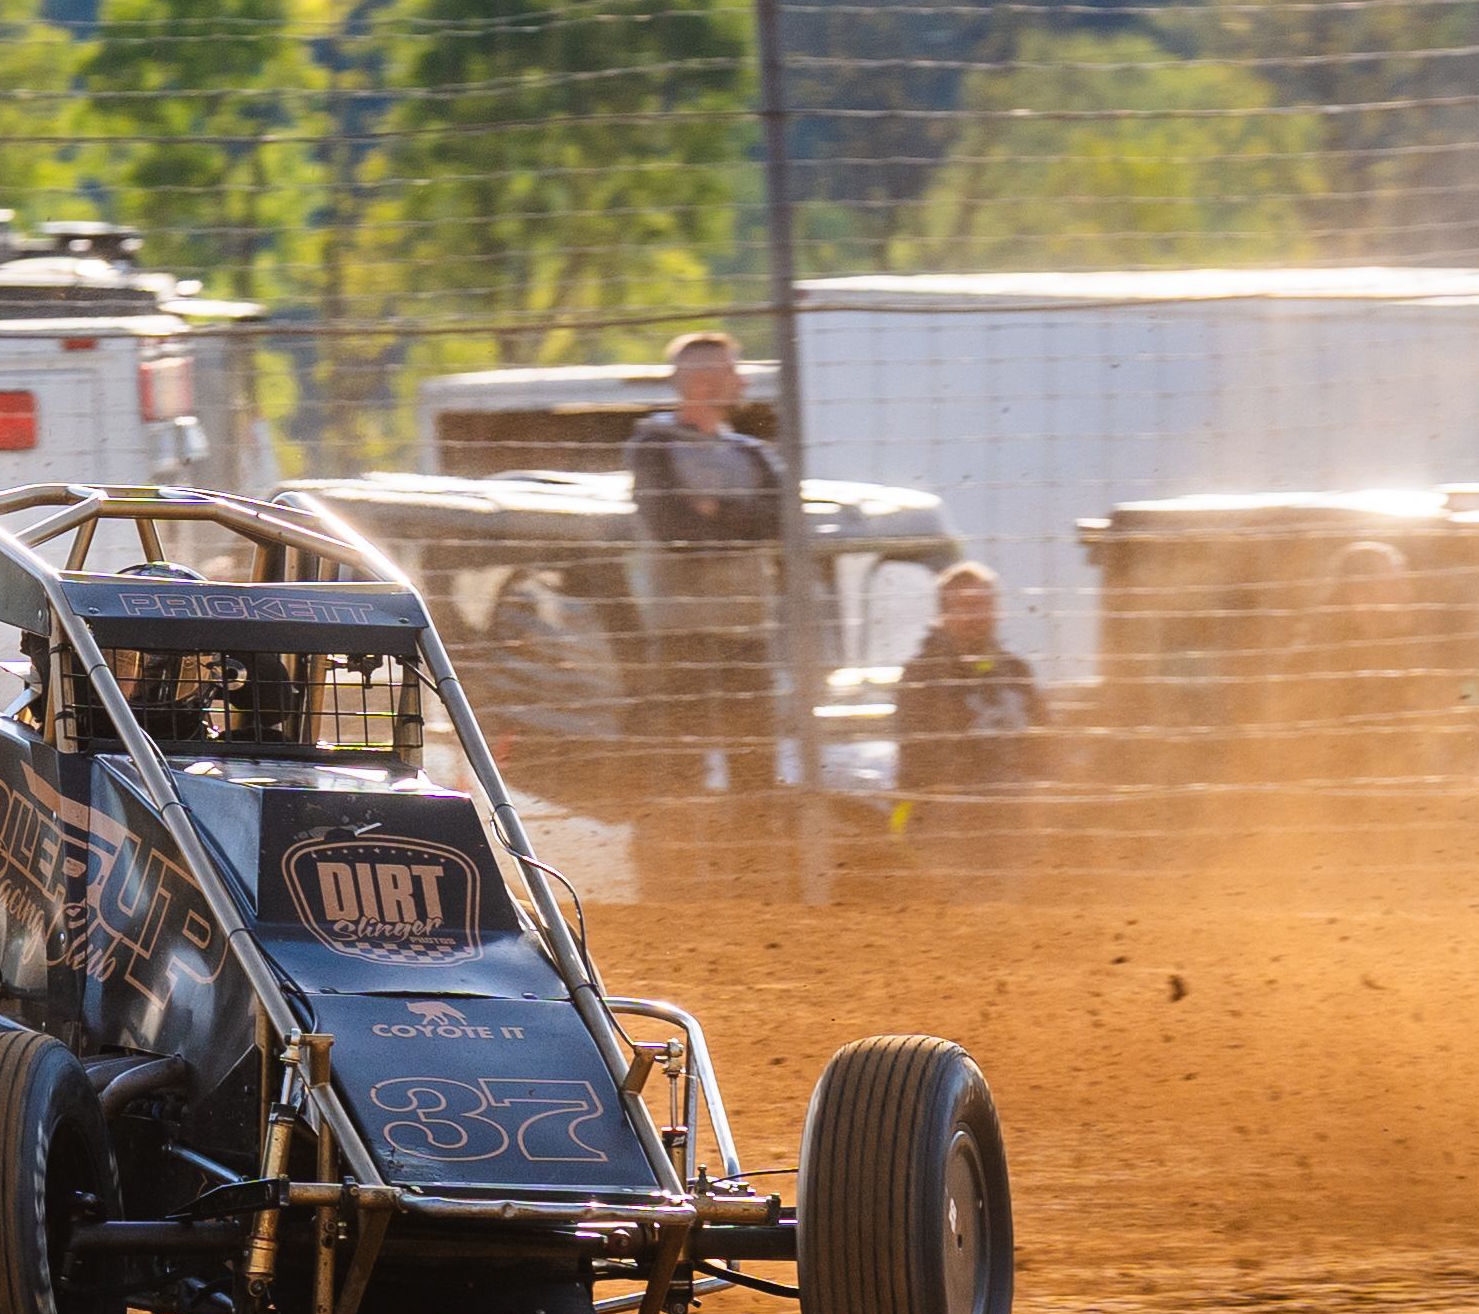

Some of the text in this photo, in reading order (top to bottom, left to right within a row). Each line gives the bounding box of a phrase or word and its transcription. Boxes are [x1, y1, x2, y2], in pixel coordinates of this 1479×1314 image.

[119, 593, 374, 624] PRICKETT
[317, 861, 445, 923] DIRT
[44, 898, 117, 982] Club
[97, 824, 231, 1011] UP
[330, 915, 445, 943] Slinger
[409, 936, 456, 946] PHOTOS
[371, 1023, 525, 1039] COYOTE IT
[370, 1076, 609, 1163] 37
